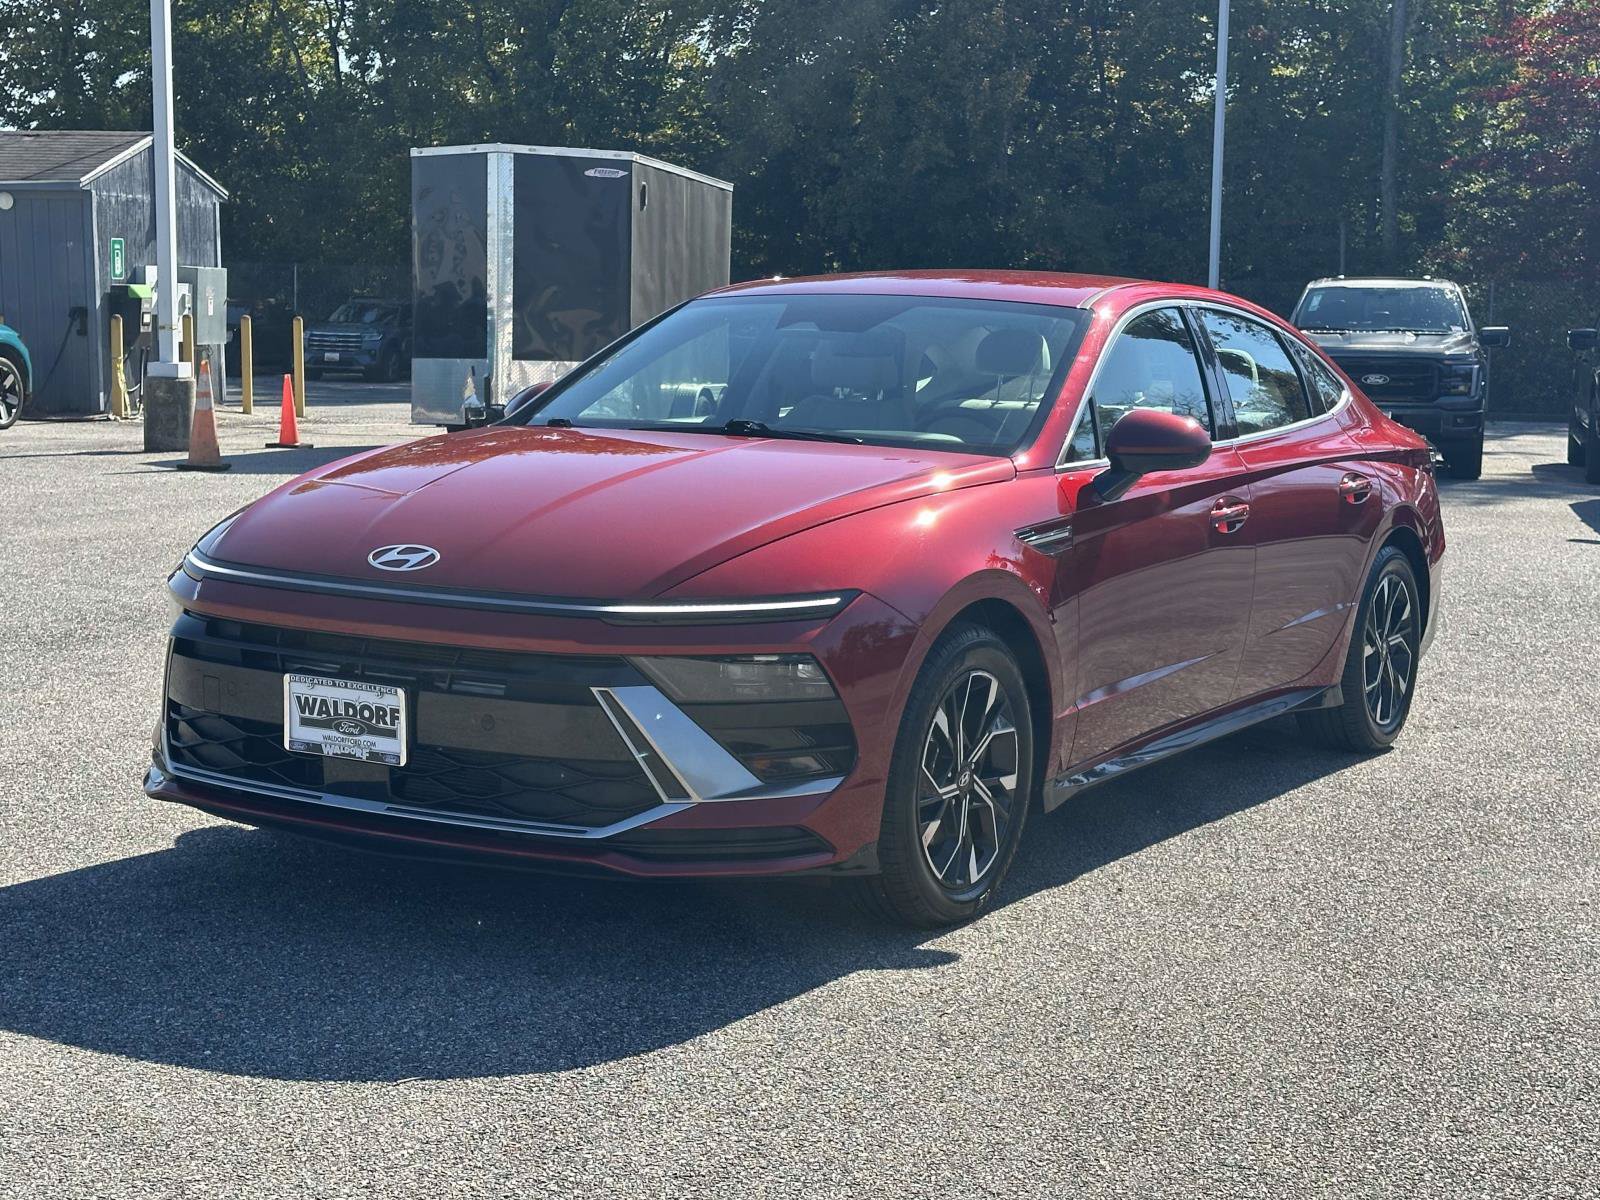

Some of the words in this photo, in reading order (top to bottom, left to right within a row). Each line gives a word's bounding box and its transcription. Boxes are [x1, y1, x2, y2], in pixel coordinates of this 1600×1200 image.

[290, 675, 333, 686] DEDICATED
[336, 680, 346, 688] TO
[347, 682, 398, 695] EXCELLENCE
[294, 695, 400, 728] WALDORF
[338, 721, 360, 735] Ford
[322, 734, 377, 748] WALDORFFORD.COM
[322, 744, 370, 760] WALDORF
